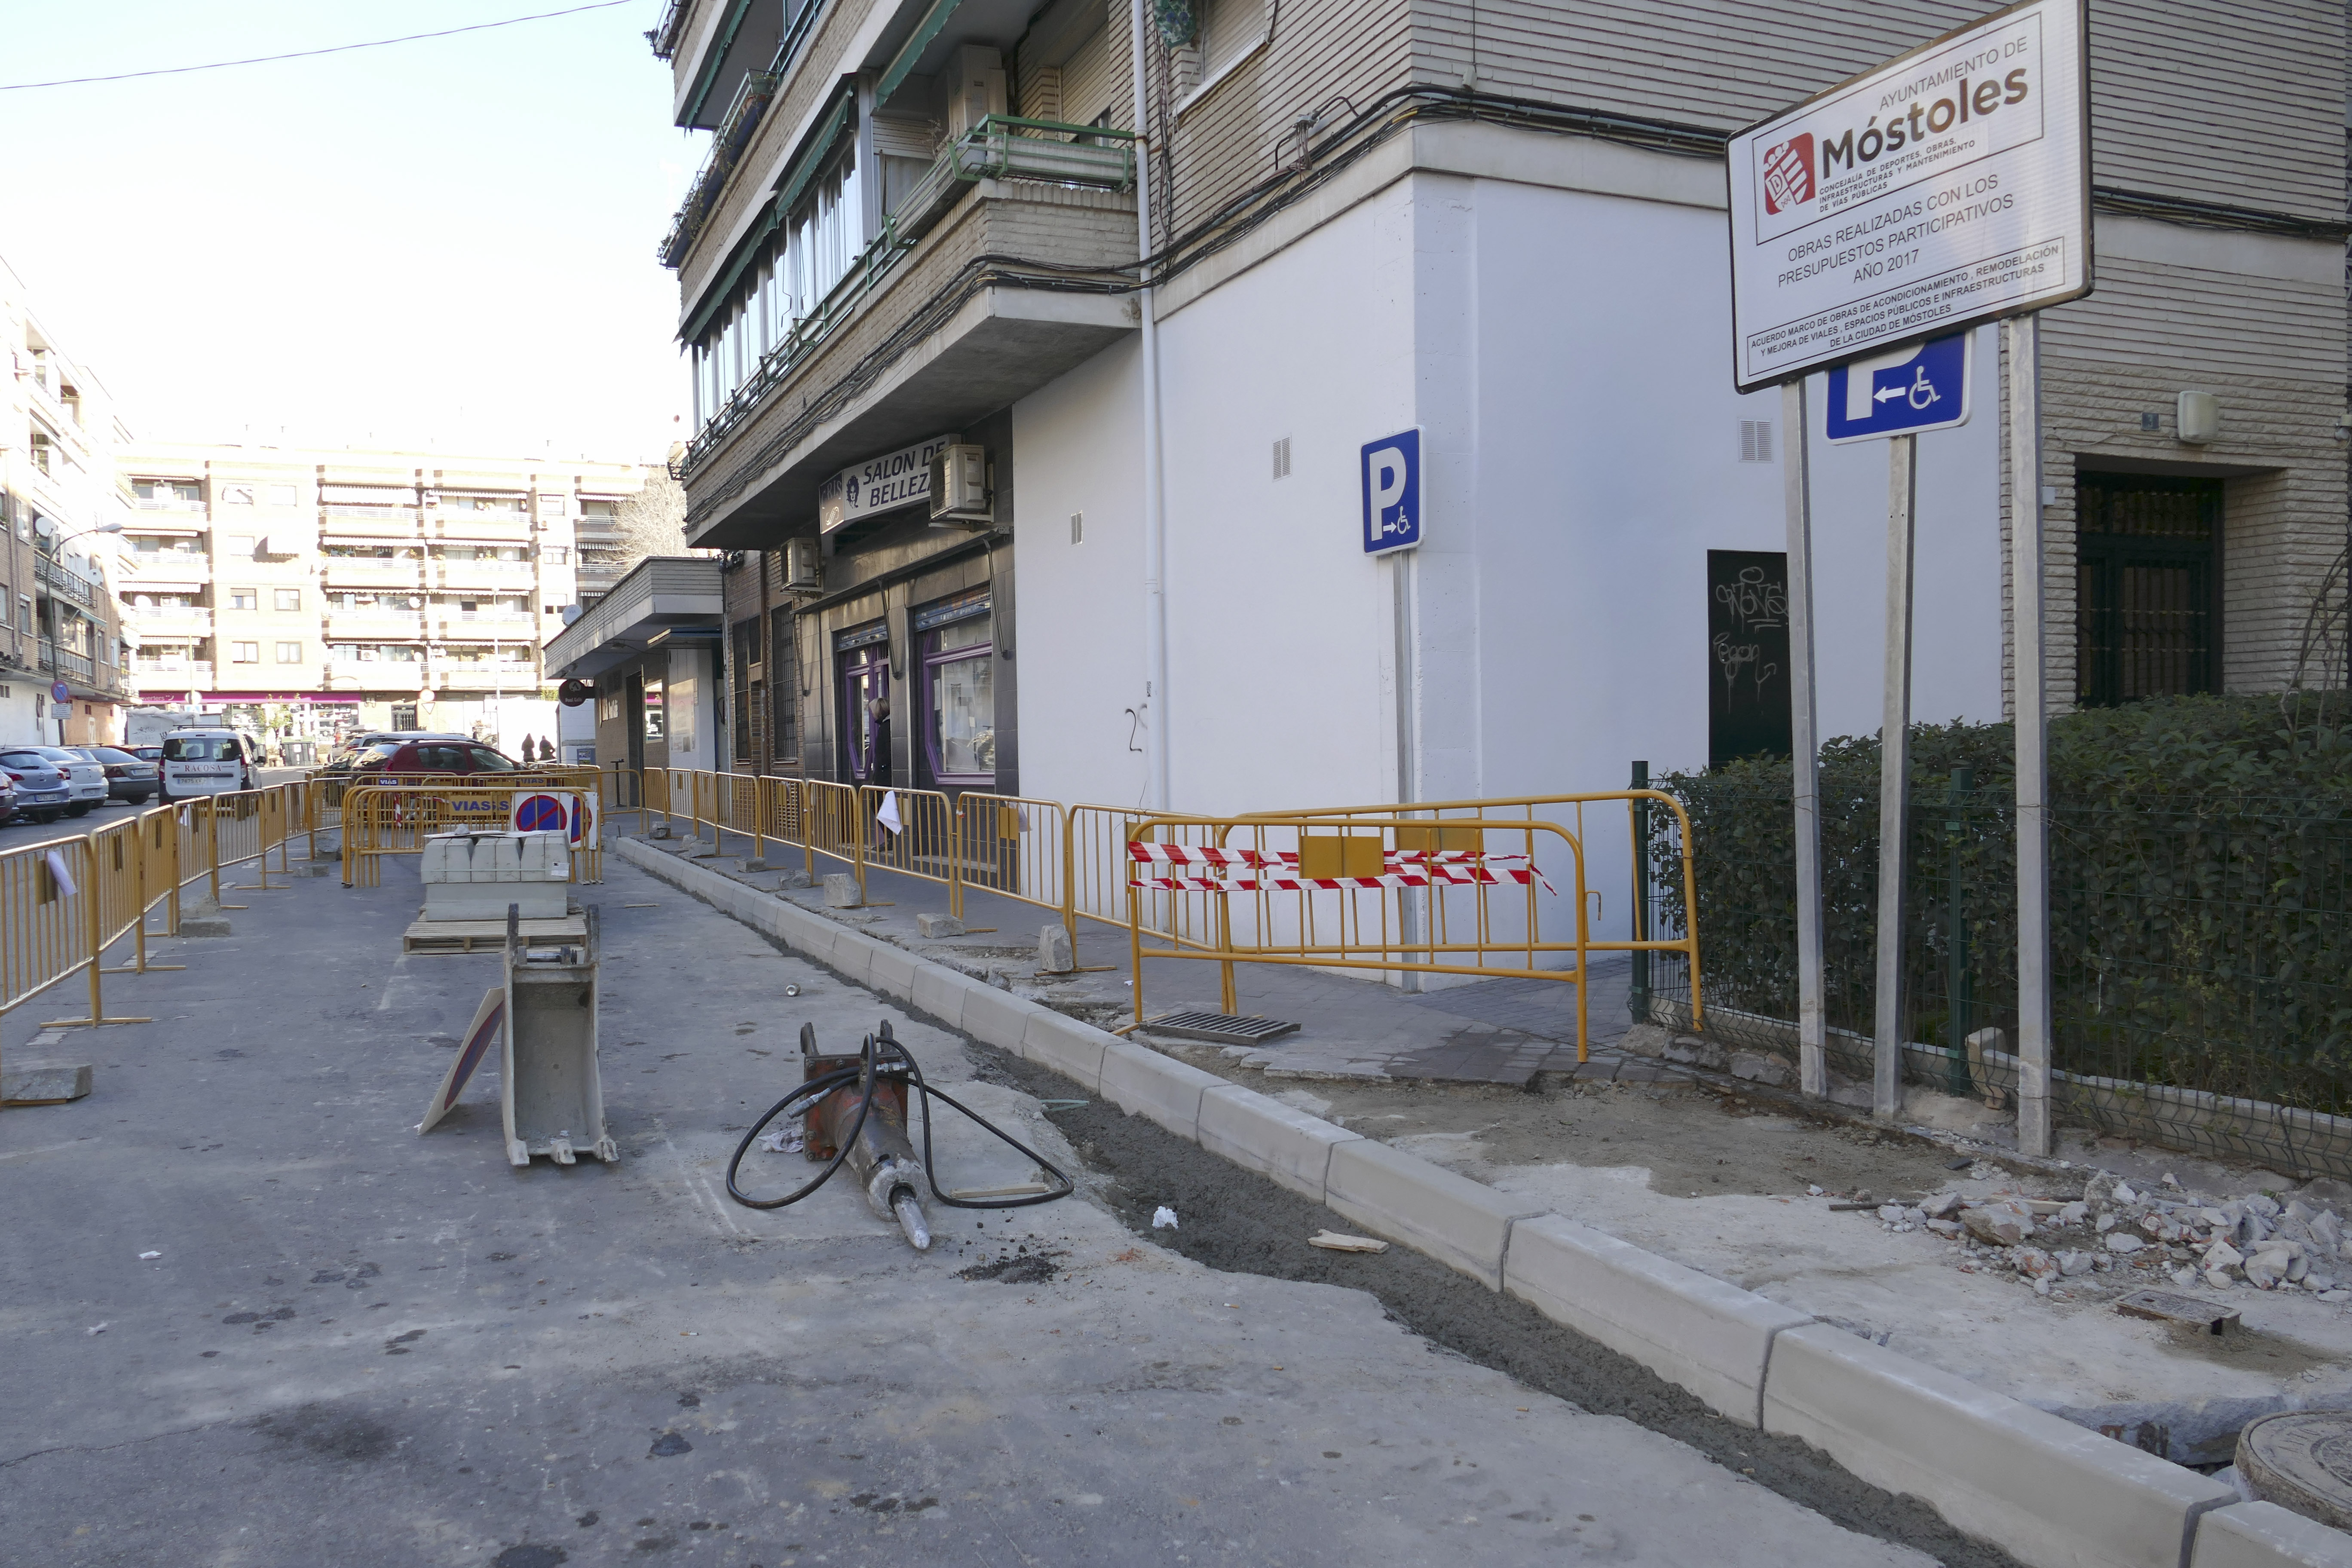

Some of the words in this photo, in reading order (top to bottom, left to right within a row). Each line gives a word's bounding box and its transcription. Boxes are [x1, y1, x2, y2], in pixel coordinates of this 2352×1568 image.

[1880, 48, 1999, 111] AYUNTAMIENTO
[2005, 36, 2027, 58] DE
[1822, 68, 2028, 180] Móstoles
[1819, 171, 1893, 204] INFRAESTRUCTURAS
[1906, 140, 1975, 171] MANTENIMIENTO
[1819, 172, 1863, 195] CONCEJALÍA
[1867, 168, 1877, 177] DE
[1880, 151, 1922, 172] DEPORTES,
[1819, 204, 1828, 213] DE
[1832, 196, 1848, 208] VÍAS
[1852, 181, 1888, 202] PÚBLICAS
[1778, 238, 1884, 288] PRESUPUESTOS
[1888, 193, 2014, 248] PARTICIPATIVOS
[1788, 235, 1832, 262] OBRAS
[1836, 201, 1922, 244] REALIZADAS
[1926, 186, 1960, 210] CON
[1966, 174, 1998, 197] LOS
[1751, 331, 1786, 349] ACUERDO
[1788, 321, 1815, 336] MARCO
[1817, 316, 1827, 327] DE
[1830, 307, 1858, 322] OBRAS
[1860, 302, 1871, 313] DE
[1873, 272, 1968, 309] ACONDICIONAMIENTO
[1976, 245, 2059, 276] REMODELACIÓN
[1853, 262, 1883, 283] AÑO
[1887, 249, 1919, 272] 2017
[1761, 349, 1766, 357] Y
[1767, 338, 1797, 355] MEJORA
[1799, 335, 1809, 345] DE
[1811, 325, 1838, 341] VIALES
[1844, 311, 1885, 331] ESPACIOS
[1887, 297, 1931, 317] PÚBLICOS
[1934, 294, 1939, 303] E
[1942, 263, 2044, 301] INFRAESTRUCTURAS
[1830, 337, 1841, 347] DE
[1843, 334, 1853, 343] LA
[1855, 324, 1886, 340] CIUDAD
[1889, 319, 1901, 329] DE
[1903, 304, 1951, 325] MÓSTOLES
[863, 450, 916, 485] SALON
[870, 472, 931, 508] BELLEZ
[1369, 447, 1406, 542] P
[451, 801, 491, 811] VIAS
